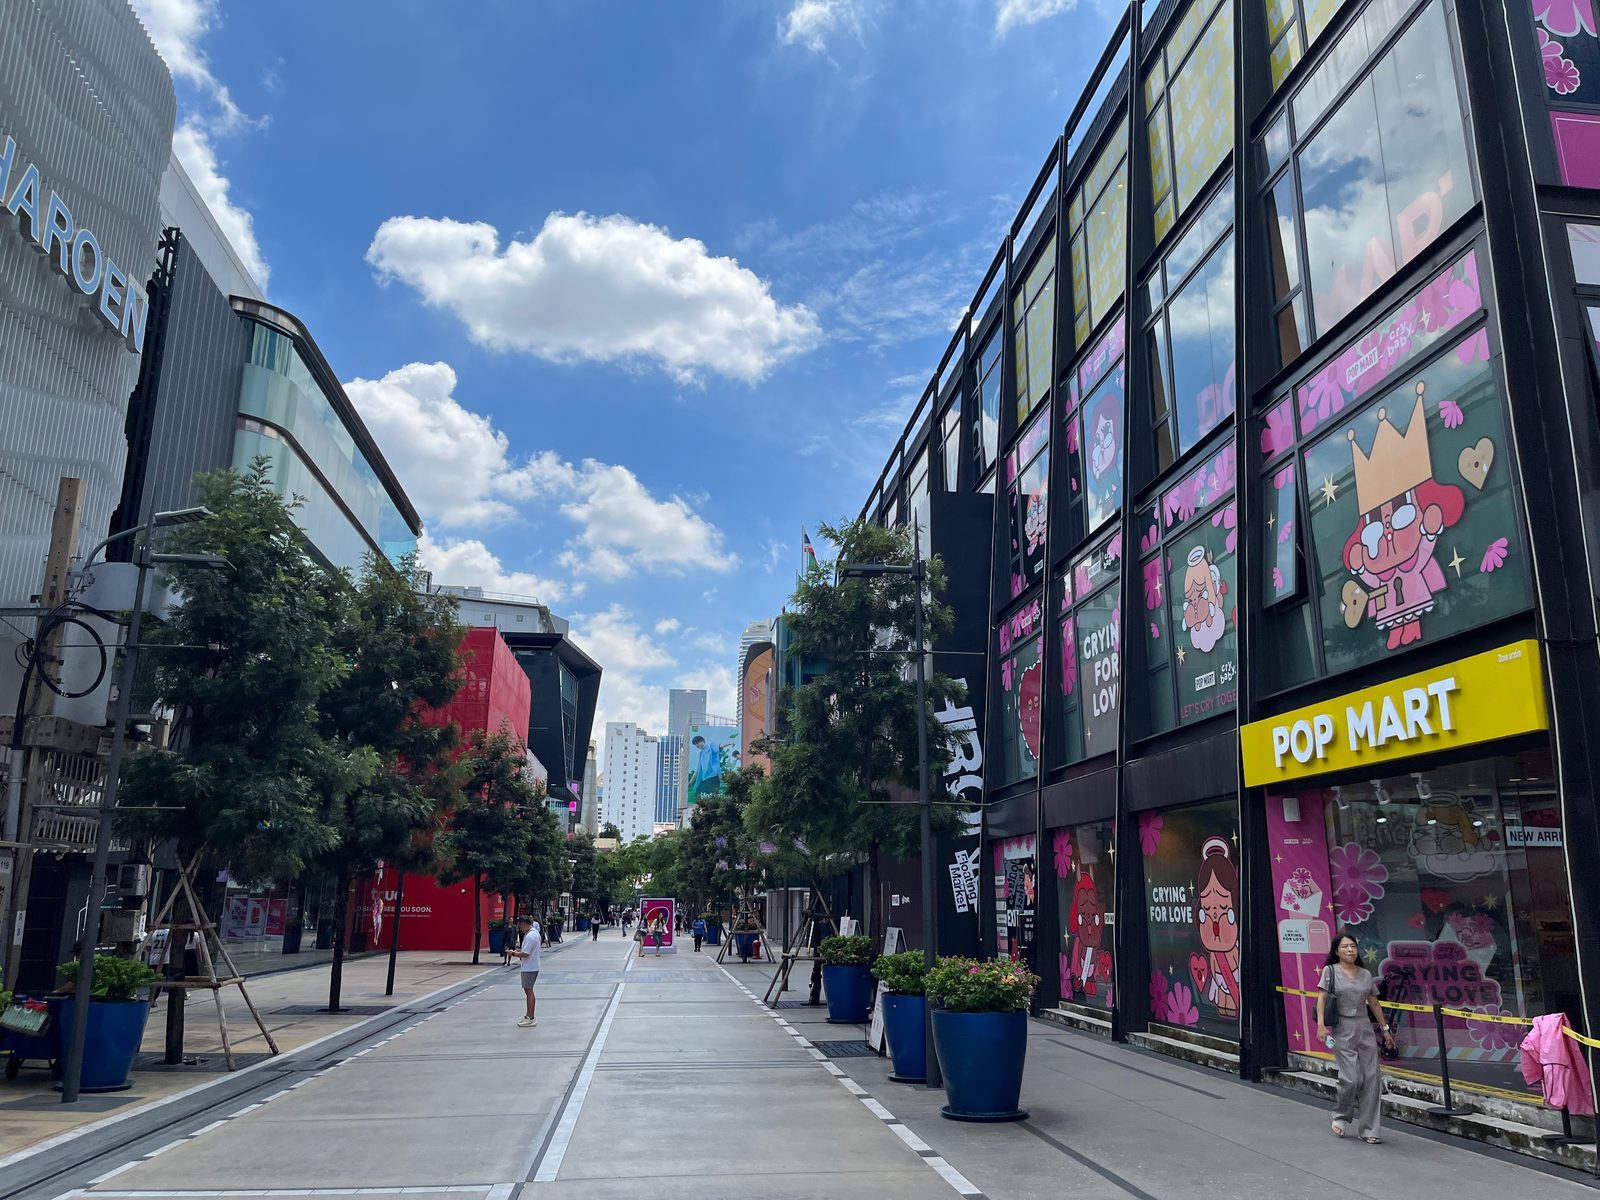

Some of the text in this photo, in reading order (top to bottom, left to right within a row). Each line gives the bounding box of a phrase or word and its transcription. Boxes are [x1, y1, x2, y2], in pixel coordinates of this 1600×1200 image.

[1094, 652, 1119, 687] FOR
[1092, 682, 1119, 717] LOV
[1181, 702, 1199, 718] LET'S
[1201, 697, 1214, 712] CRY
[1272, 677, 1456, 768] POP MART
[1509, 831, 1534, 842] NEW
[950, 867, 967, 909] Market
[1152, 887, 1186, 903] CRYING
[1150, 906, 1193, 923] FOR LOVE
[1430, 984, 1494, 1004] LOVE
